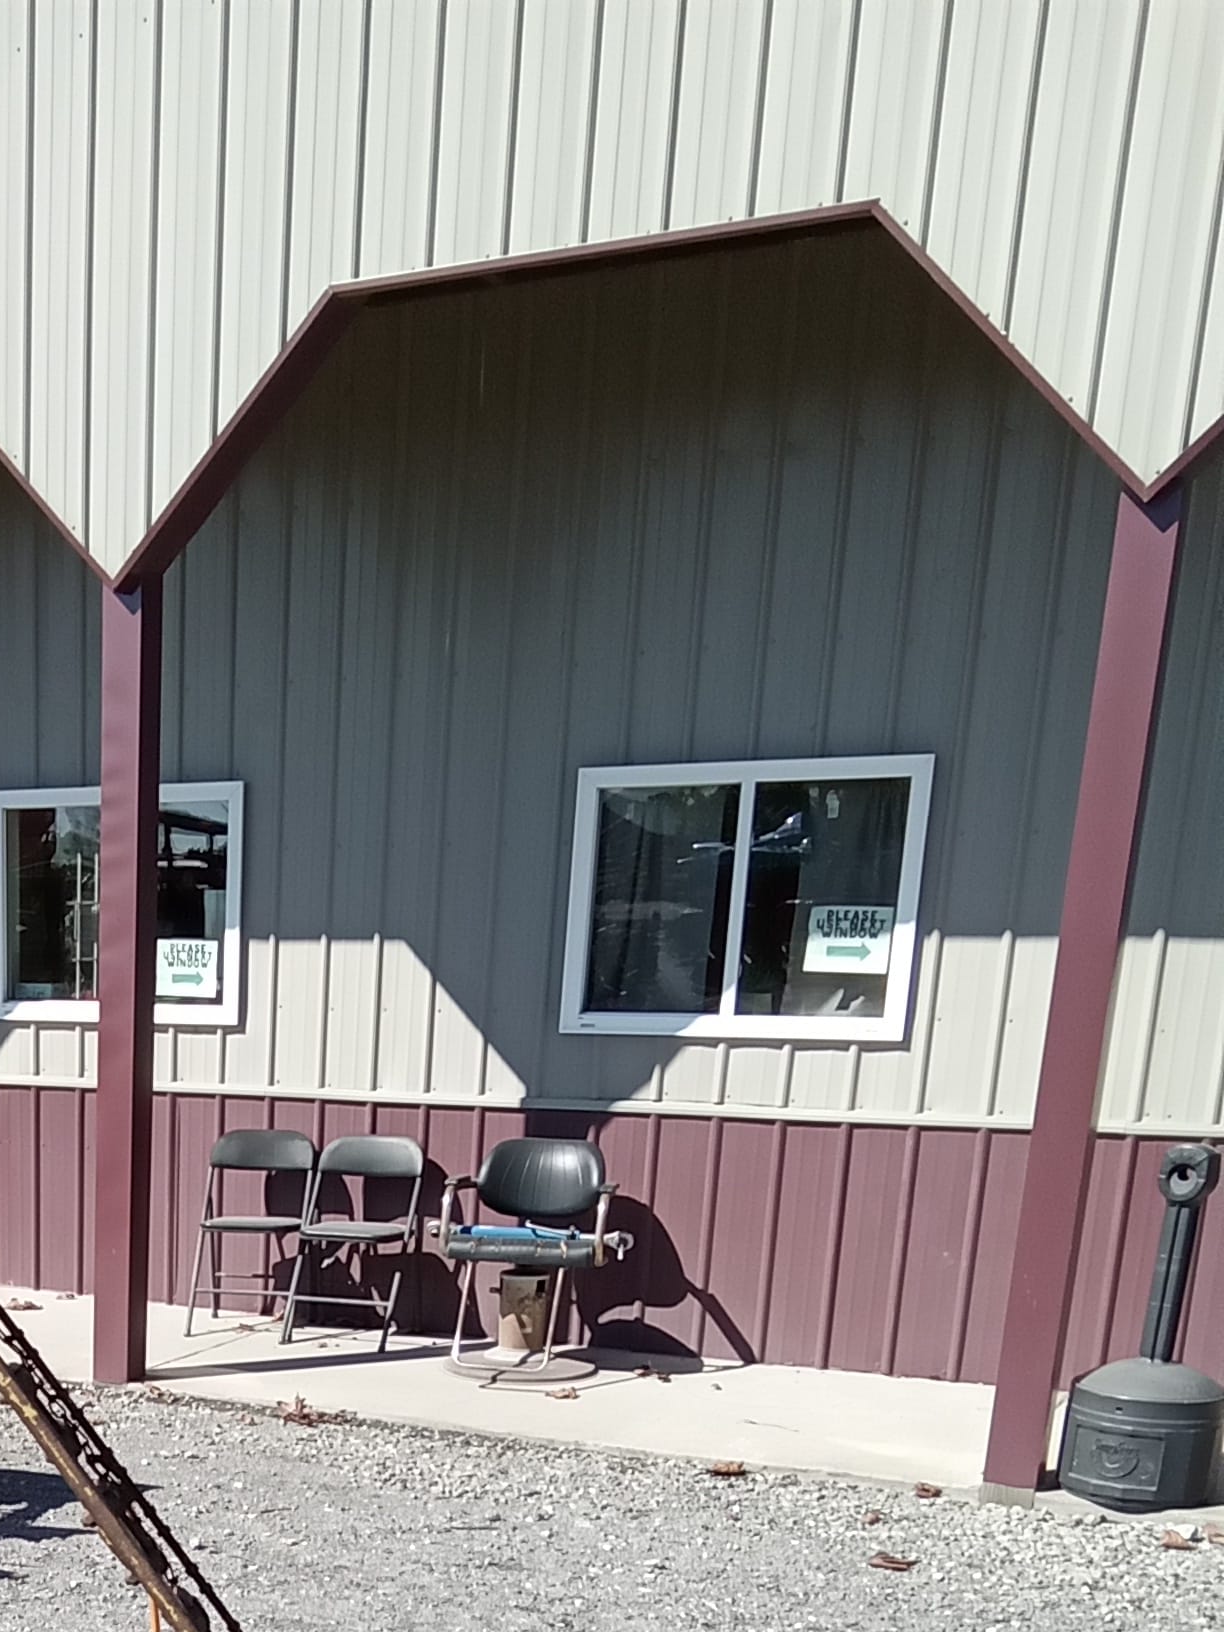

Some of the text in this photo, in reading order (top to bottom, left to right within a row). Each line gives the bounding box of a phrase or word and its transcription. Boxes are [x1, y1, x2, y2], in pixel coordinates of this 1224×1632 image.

[827, 909, 878, 922] PLEASE
[817, 918, 840, 931] USE
[821, 927, 882, 939] WINDOW
[169, 943, 207, 953] PLEASE
[167, 959, 210, 968] WINDOW
